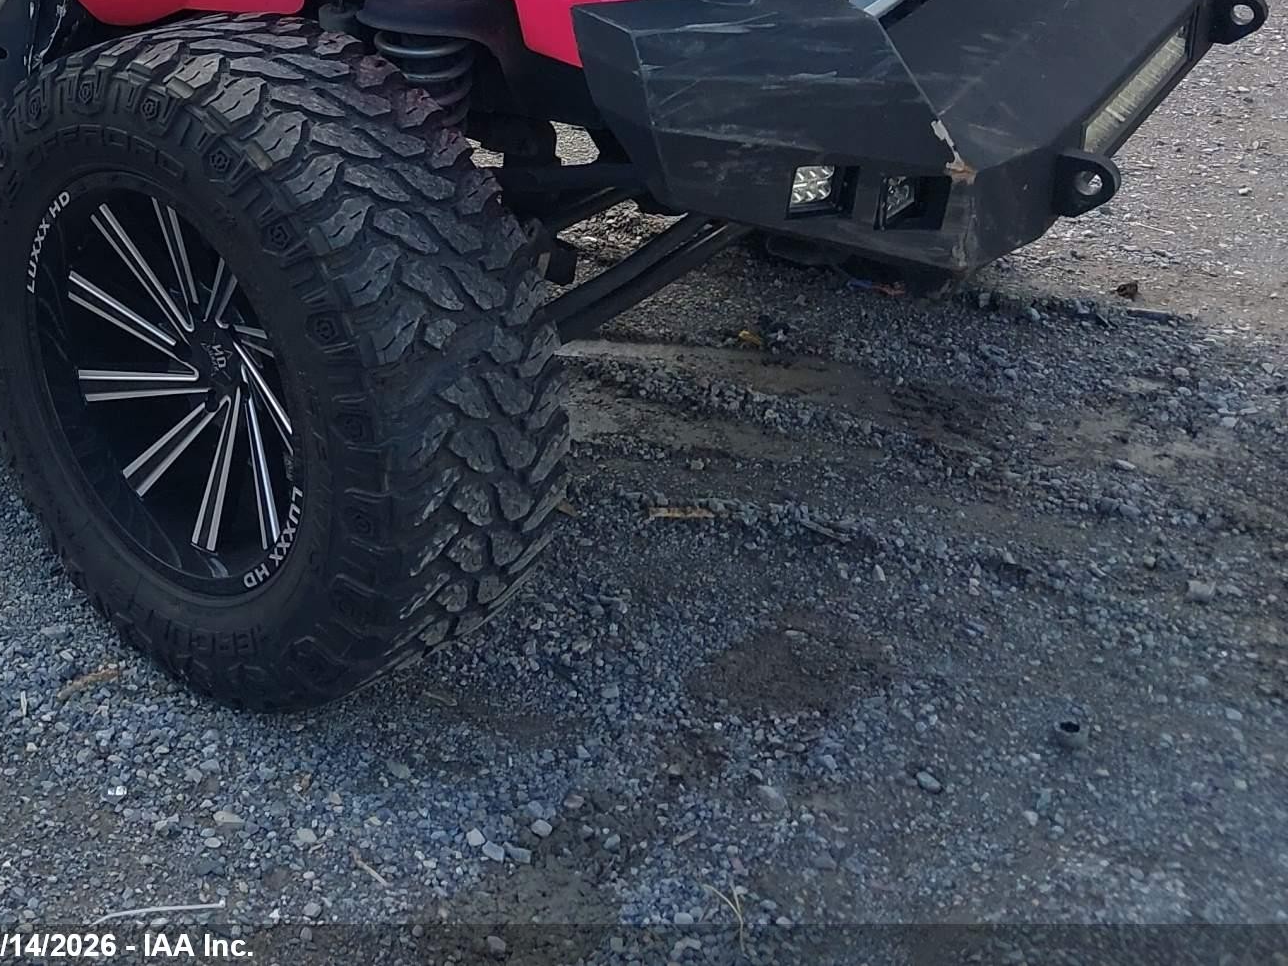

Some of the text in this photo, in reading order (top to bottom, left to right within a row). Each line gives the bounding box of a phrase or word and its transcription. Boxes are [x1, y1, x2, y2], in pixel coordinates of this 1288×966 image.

[27, 191, 70, 294] LUXXX HD
[243, 486, 304, 588] LUXXX HD
